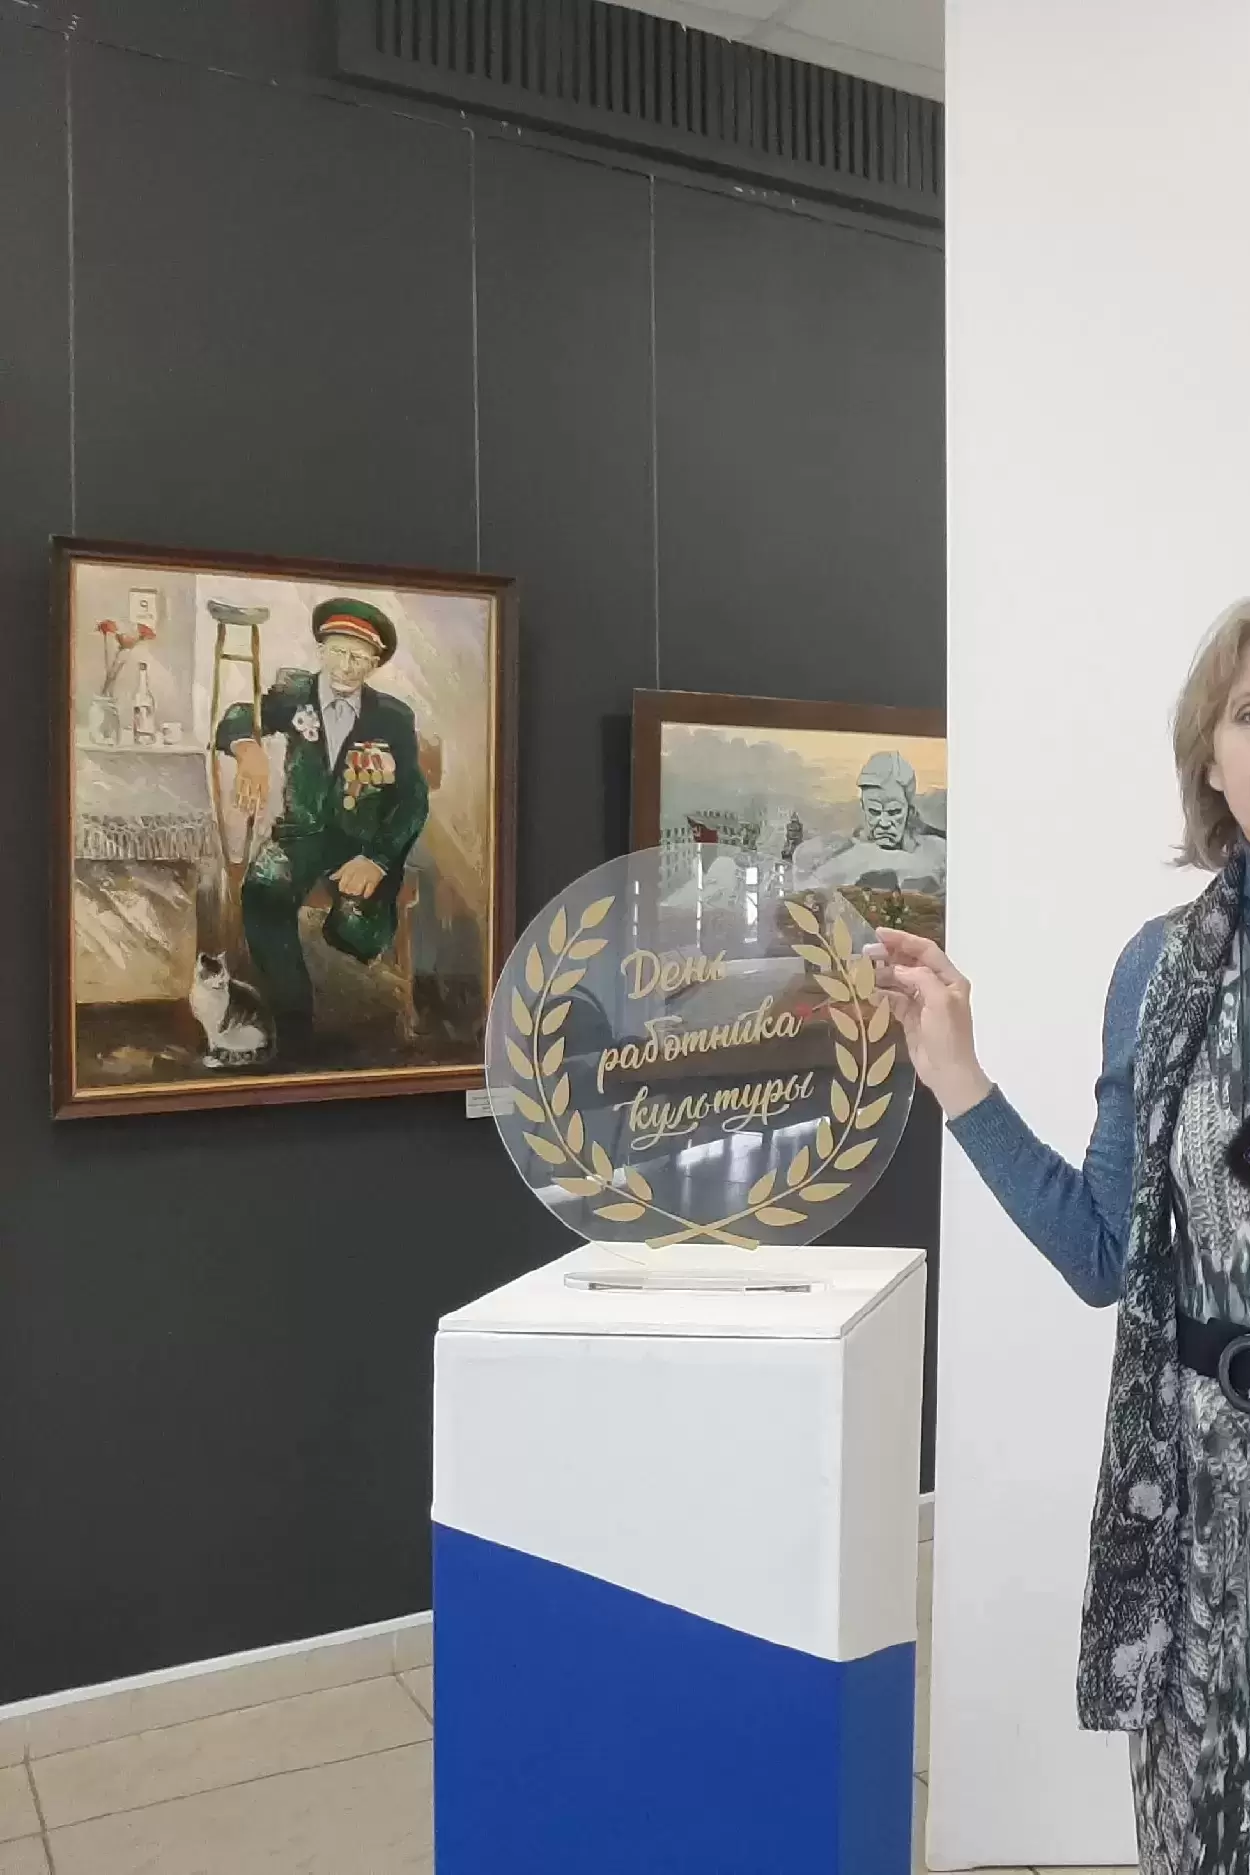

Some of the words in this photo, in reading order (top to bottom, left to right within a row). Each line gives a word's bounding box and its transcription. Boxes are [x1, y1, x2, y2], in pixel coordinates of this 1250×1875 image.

[620, 949, 728, 1000] День
[597, 995, 804, 1094] работника
[612, 1071, 815, 1150] культуры
